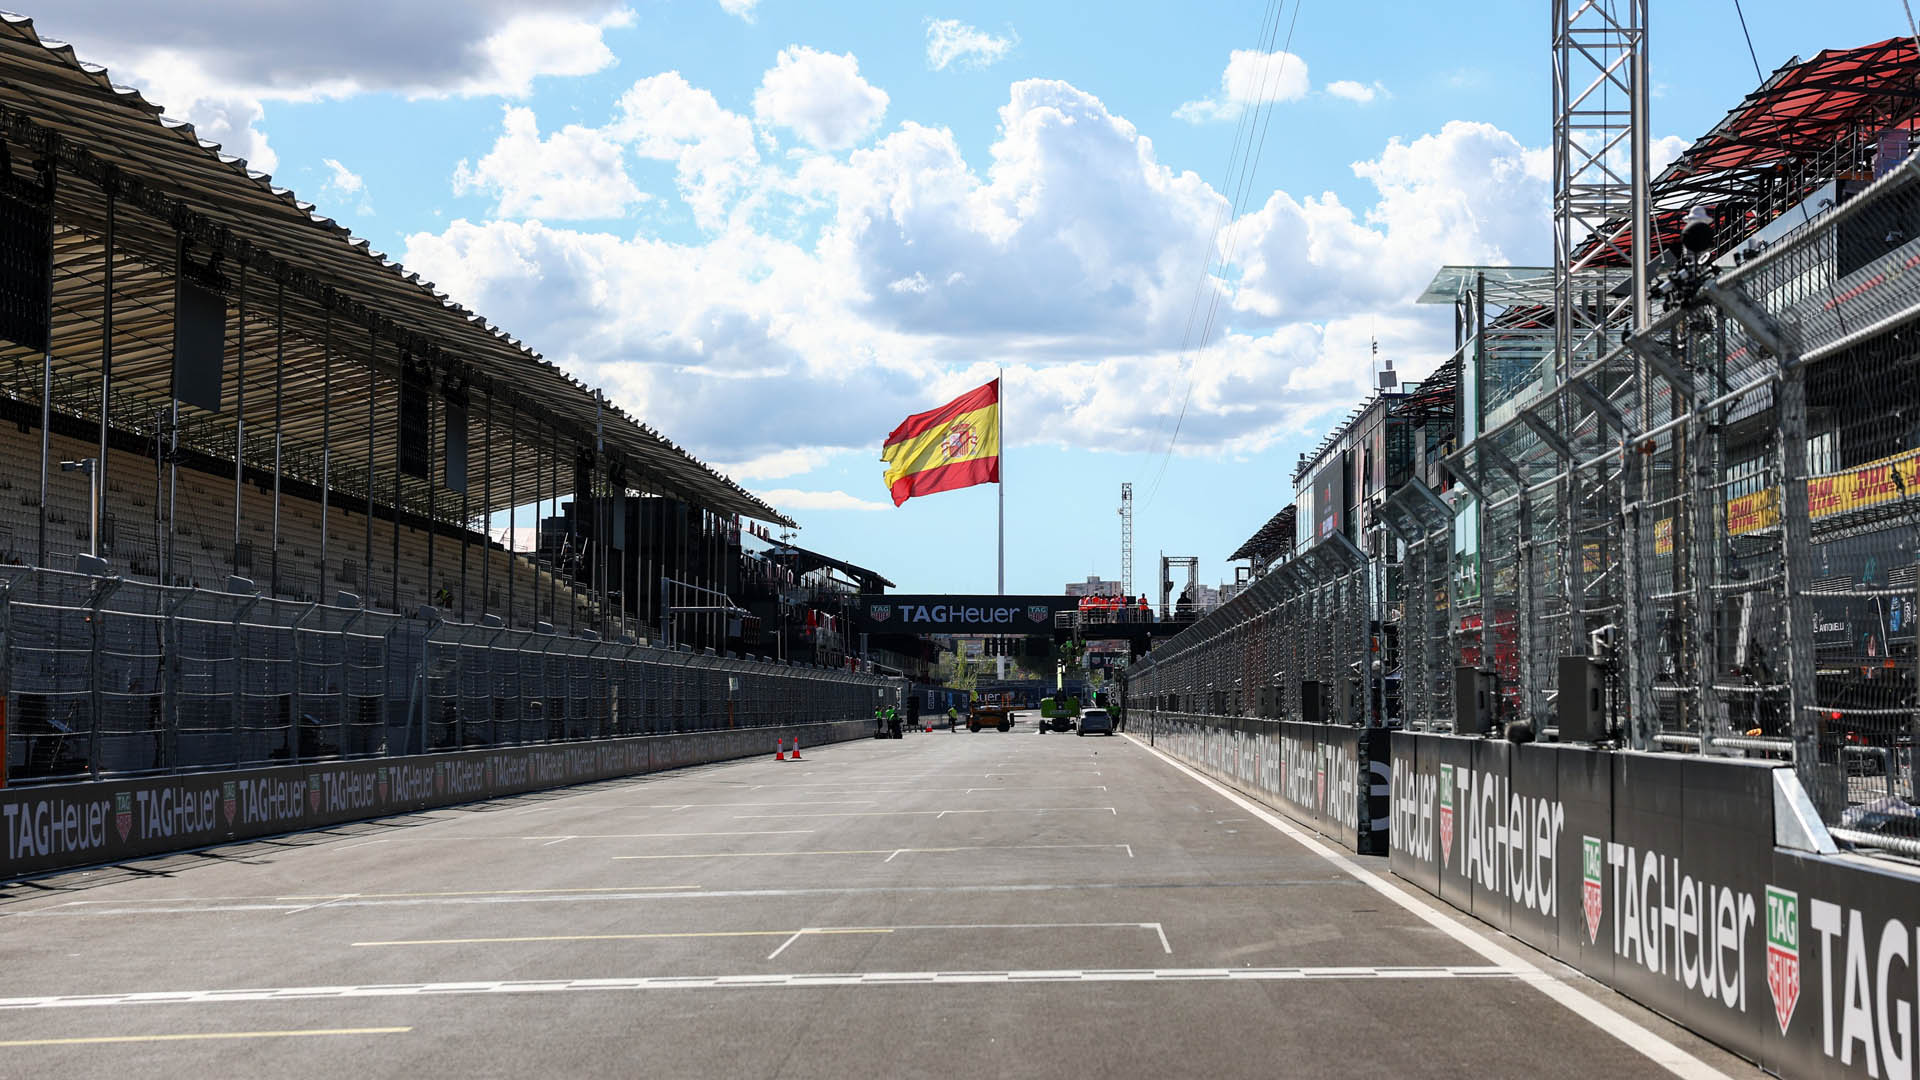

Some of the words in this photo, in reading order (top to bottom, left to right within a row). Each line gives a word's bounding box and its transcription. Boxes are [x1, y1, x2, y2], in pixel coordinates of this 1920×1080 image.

[3, 799, 110, 859] TAGHeuer
[136, 787, 219, 839] TAGHeuer
[240, 777, 306, 823] TAGHeuer
[1457, 767, 1564, 918] TAGHeuer
[1607, 842, 1756, 1013] TAGHeuer
[1769, 895, 1796, 946] TAG
[1811, 898, 1920, 1080] TAG
